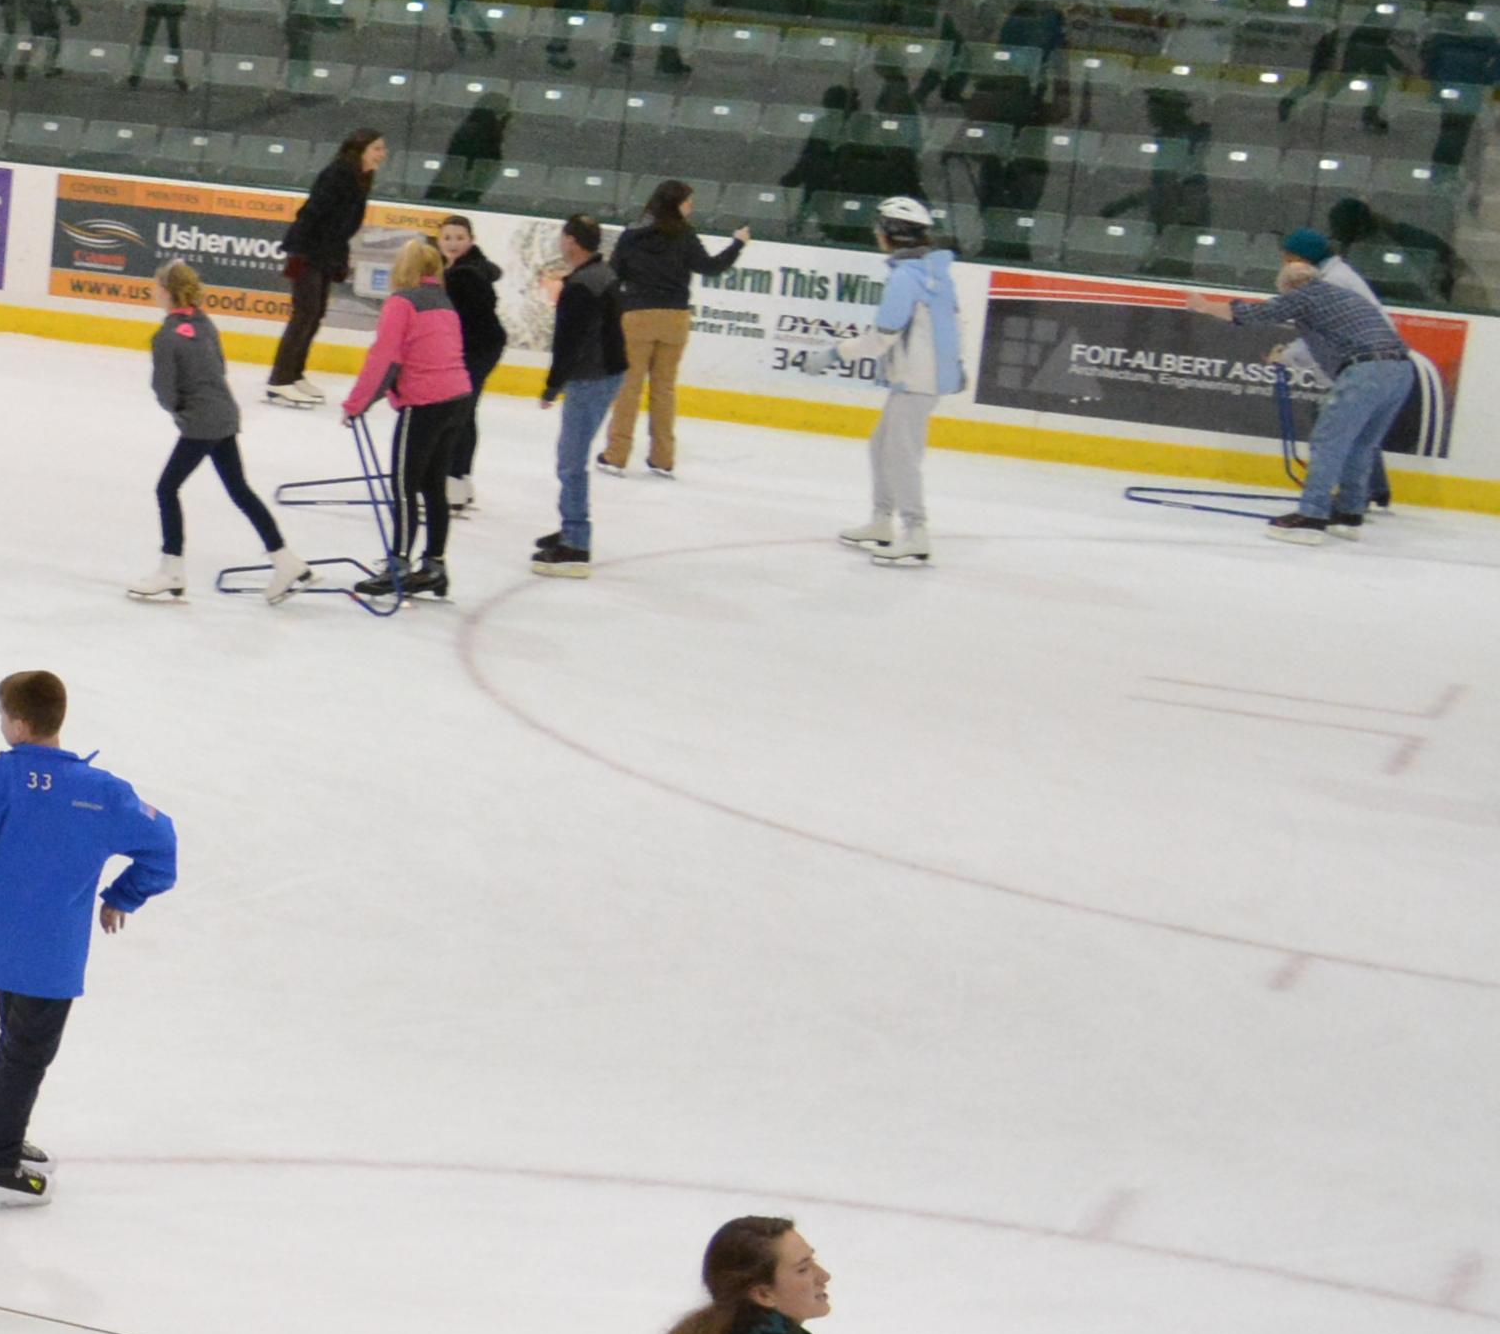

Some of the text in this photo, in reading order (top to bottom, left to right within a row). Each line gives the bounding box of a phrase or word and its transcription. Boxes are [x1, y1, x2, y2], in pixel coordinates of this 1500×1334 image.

[247, 199, 285, 213] COLOR
[780, 266, 831, 301] This
[726, 323, 766, 340] From
[1070, 343, 1227, 378] FOIT-ALBERT
[1159, 373, 1243, 396] Engineering
[26, 771, 53, 791] 33
